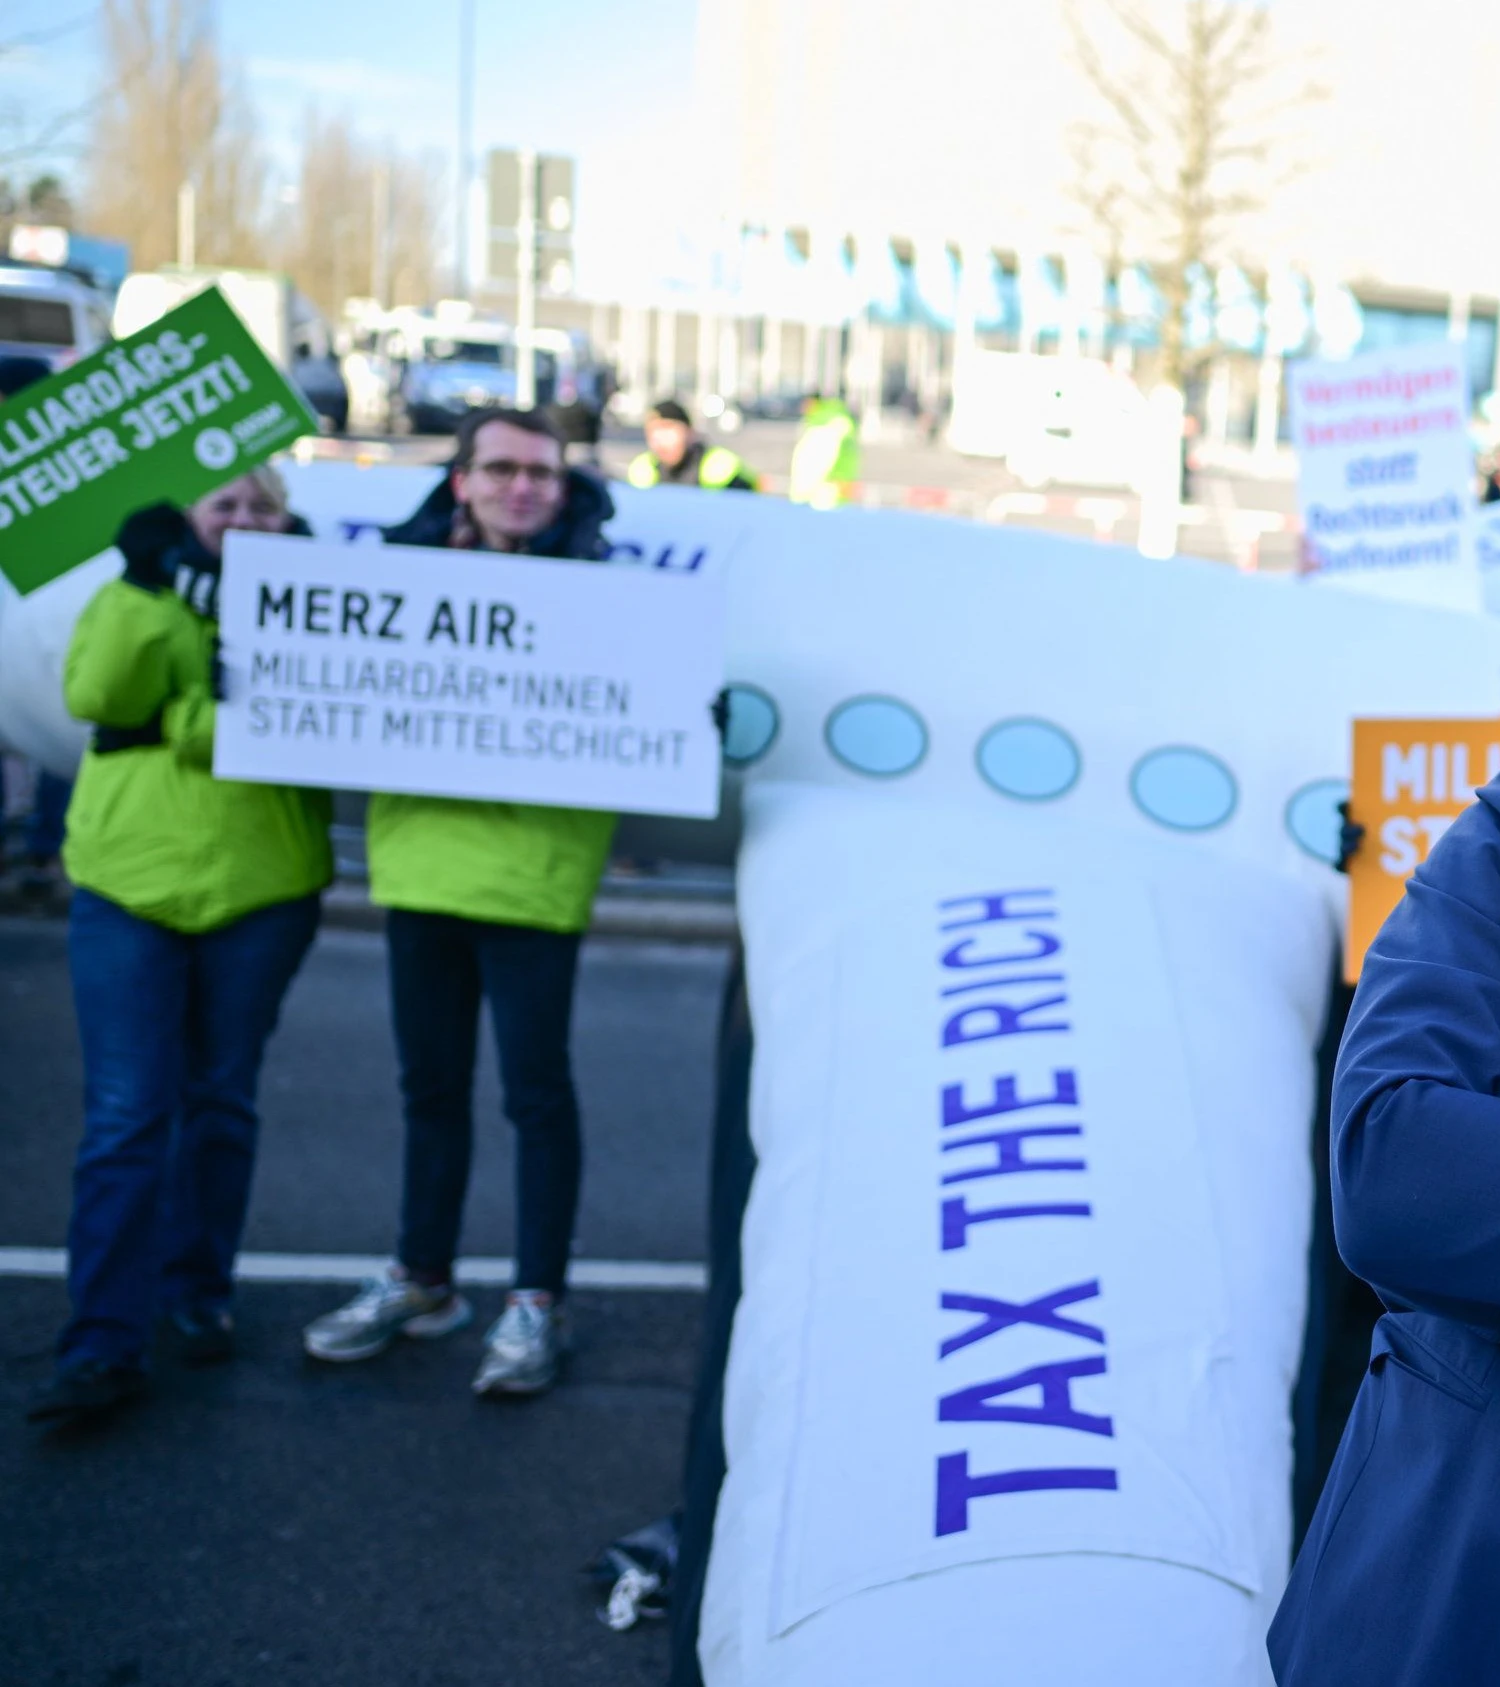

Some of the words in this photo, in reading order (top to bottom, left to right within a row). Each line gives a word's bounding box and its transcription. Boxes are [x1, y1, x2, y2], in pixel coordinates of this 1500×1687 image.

[120, 354, 252, 450] JETZT!
[255, 580, 407, 641] MERZ
[424, 598, 537, 655] AIR:
[247, 694, 370, 740] STATT
[380, 708, 690, 768] MITTELSCHICHT
[938, 886, 1072, 1049] RICH
[937, 1066, 1095, 1255] THE
[930, 1276, 1122, 1540] TAX
